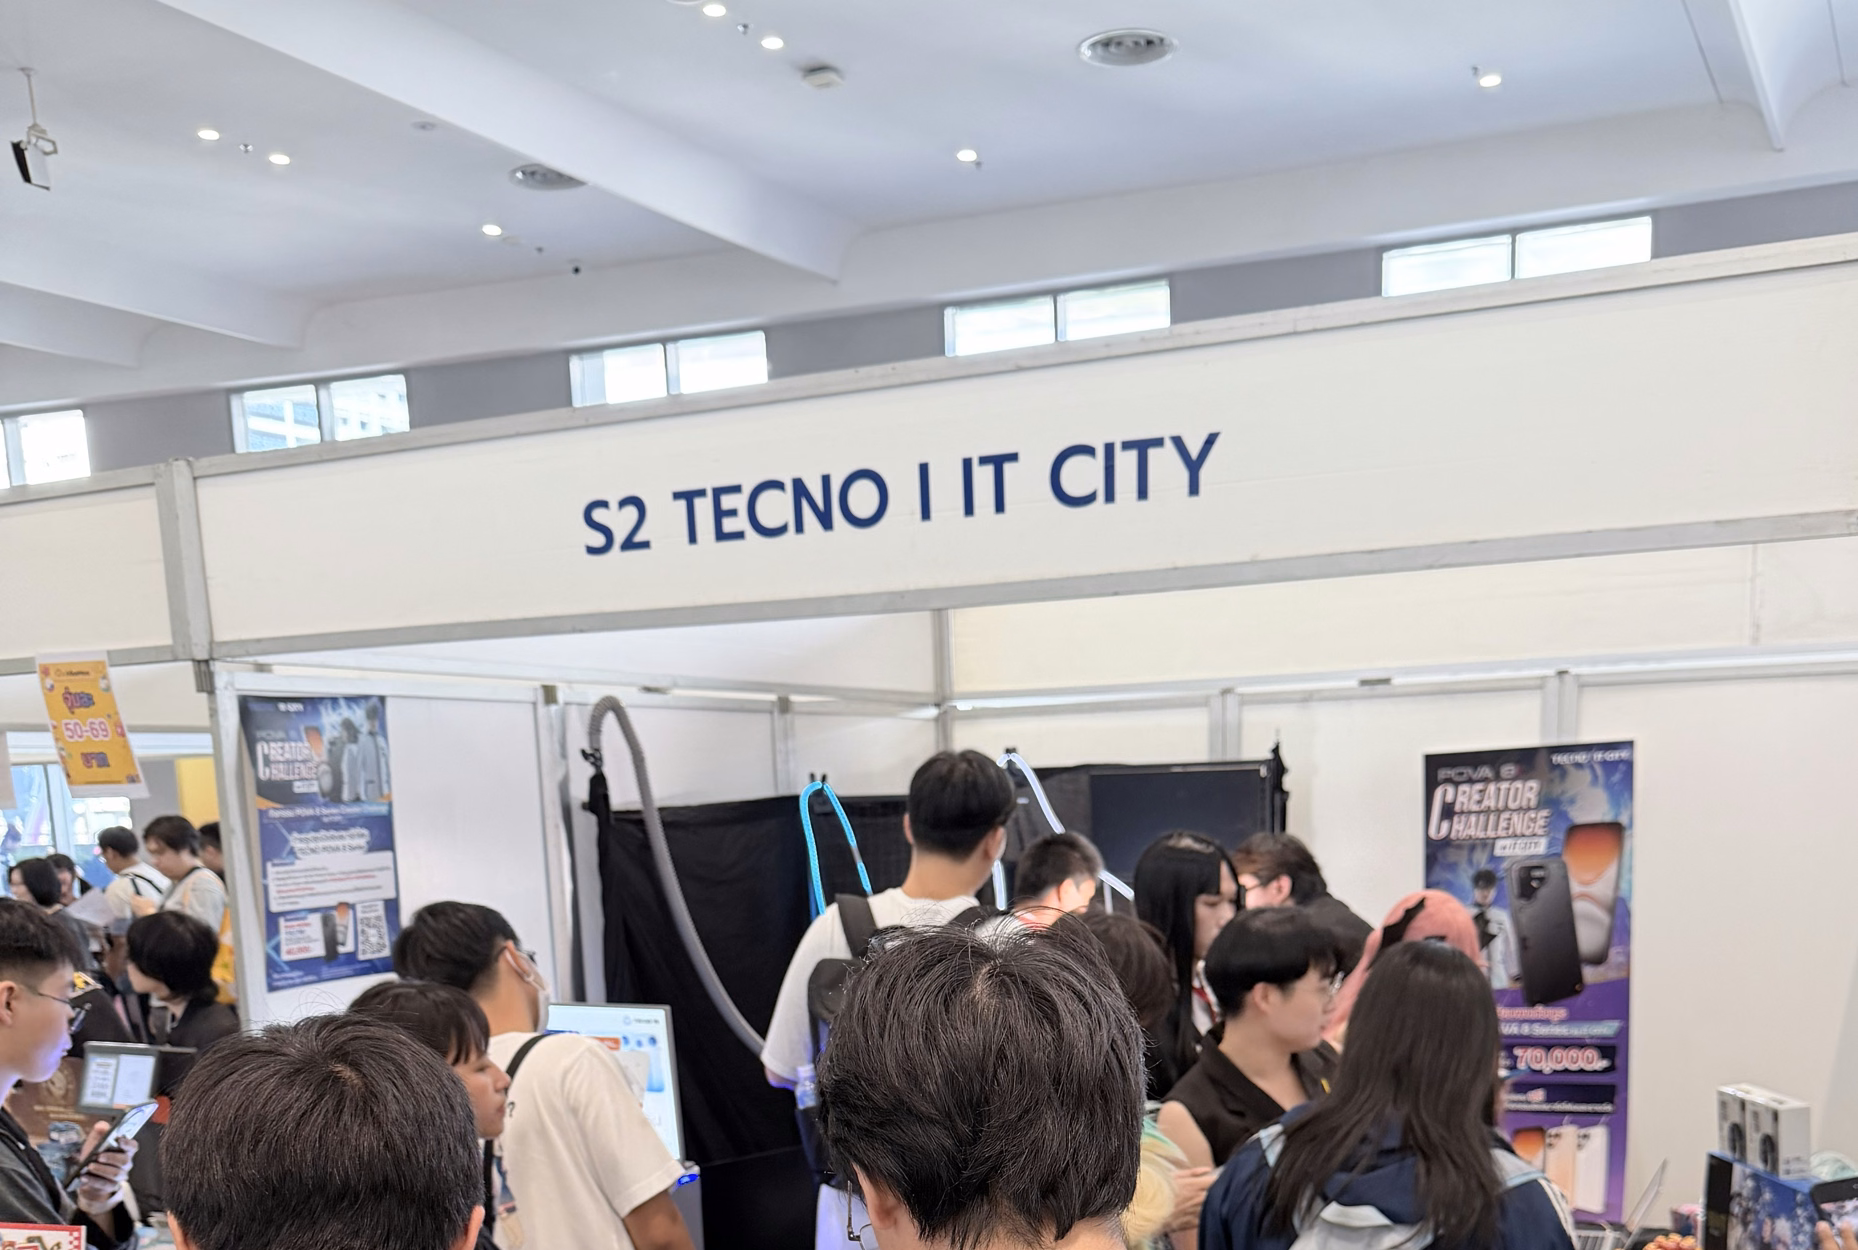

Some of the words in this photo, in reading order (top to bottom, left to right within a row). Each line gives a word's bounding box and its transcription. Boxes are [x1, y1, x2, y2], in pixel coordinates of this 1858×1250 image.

[584, 496, 650, 555] S2
[672, 469, 888, 545] TECNO
[962, 452, 1018, 517] IT
[1050, 432, 1219, 508] CITY
[62, 718, 111, 741] 50-69
[1428, 779, 1541, 822] CREATOR
[1428, 805, 1550, 840] CHALLENGE
